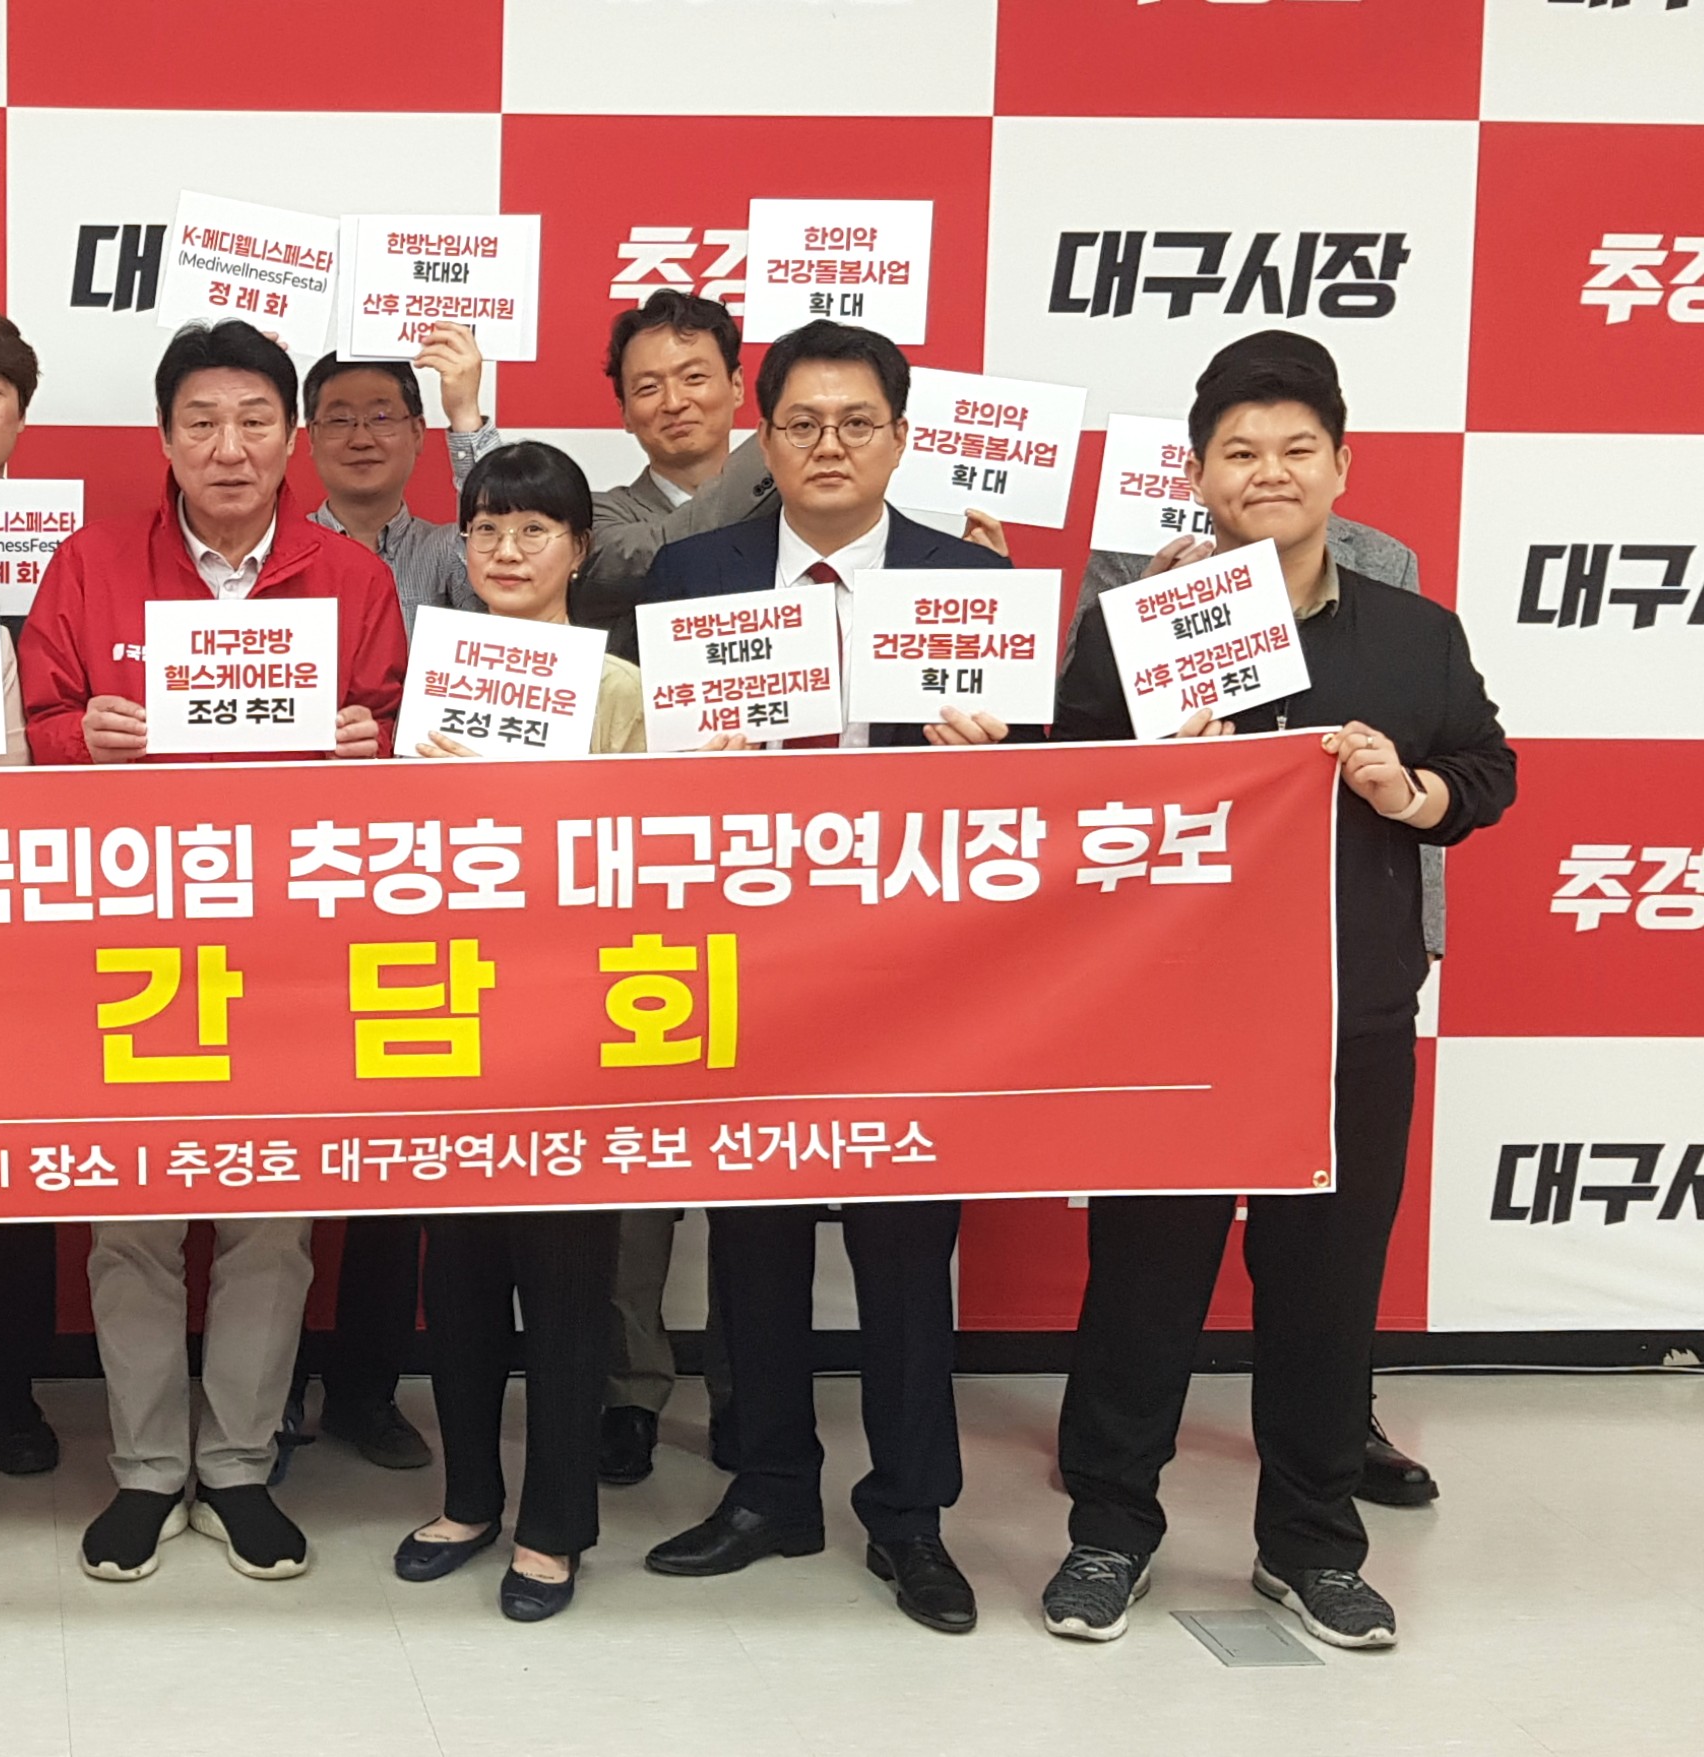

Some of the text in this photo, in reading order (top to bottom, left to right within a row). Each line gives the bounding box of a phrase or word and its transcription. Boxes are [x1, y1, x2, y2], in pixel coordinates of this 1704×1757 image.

[182, 225, 333, 273] K-메디웰니스페스타
[387, 232, 498, 258] 한방난임사업
[804, 226, 878, 252] 한의약
[179, 251, 327, 294] (MediwellnessFesta)
[413, 260, 470, 284] 확대와
[767, 259, 910, 285] 건강돌봄사업
[1048, 231, 1411, 319] 대구시장
[363, 293, 514, 320] 산후 건강관리지원
[954, 399, 1029, 432] 한의약
[911, 421, 1059, 467] 건강돌봄사업
[1135, 565, 1253, 623] 한방난임사업
[1516, 543, 1704, 630] 대구
[671, 603, 803, 642] 한방난임사업
[914, 598, 998, 625] 한의약
[1171, 603, 1232, 640] 확대와
[191, 628, 294, 656] 대구한방
[455, 640, 558, 677] 대구한방
[705, 636, 773, 666] 확대와
[872, 633, 1036, 660] 건강돌봄사업
[1134, 624, 1291, 696] 산후 건강관리지원
[164, 662, 318, 691] 헬스케어타운
[424, 670, 577, 716] 헬스케어타운
[653, 667, 831, 710] 산후 건강관리지원
[1181, 666, 1261, 711] 사업 추진
[187, 697, 295, 725] 조성 추진
[439, 707, 549, 748] 조성 추진
[698, 700, 790, 732] 사업 추진
[287, 818, 526, 918] 추경호
[557, 806, 1047, 910] 대구광역시장
[1076, 800, 1233, 893] 후보
[29, 1144, 119, 1191] 장소
[166, 1140, 301, 1188] 추경호
[321, 1129, 587, 1182] 대구광역시장
[602, 1126, 692, 1174] 후보
[709, 1120, 937, 1171] 선거사무소
